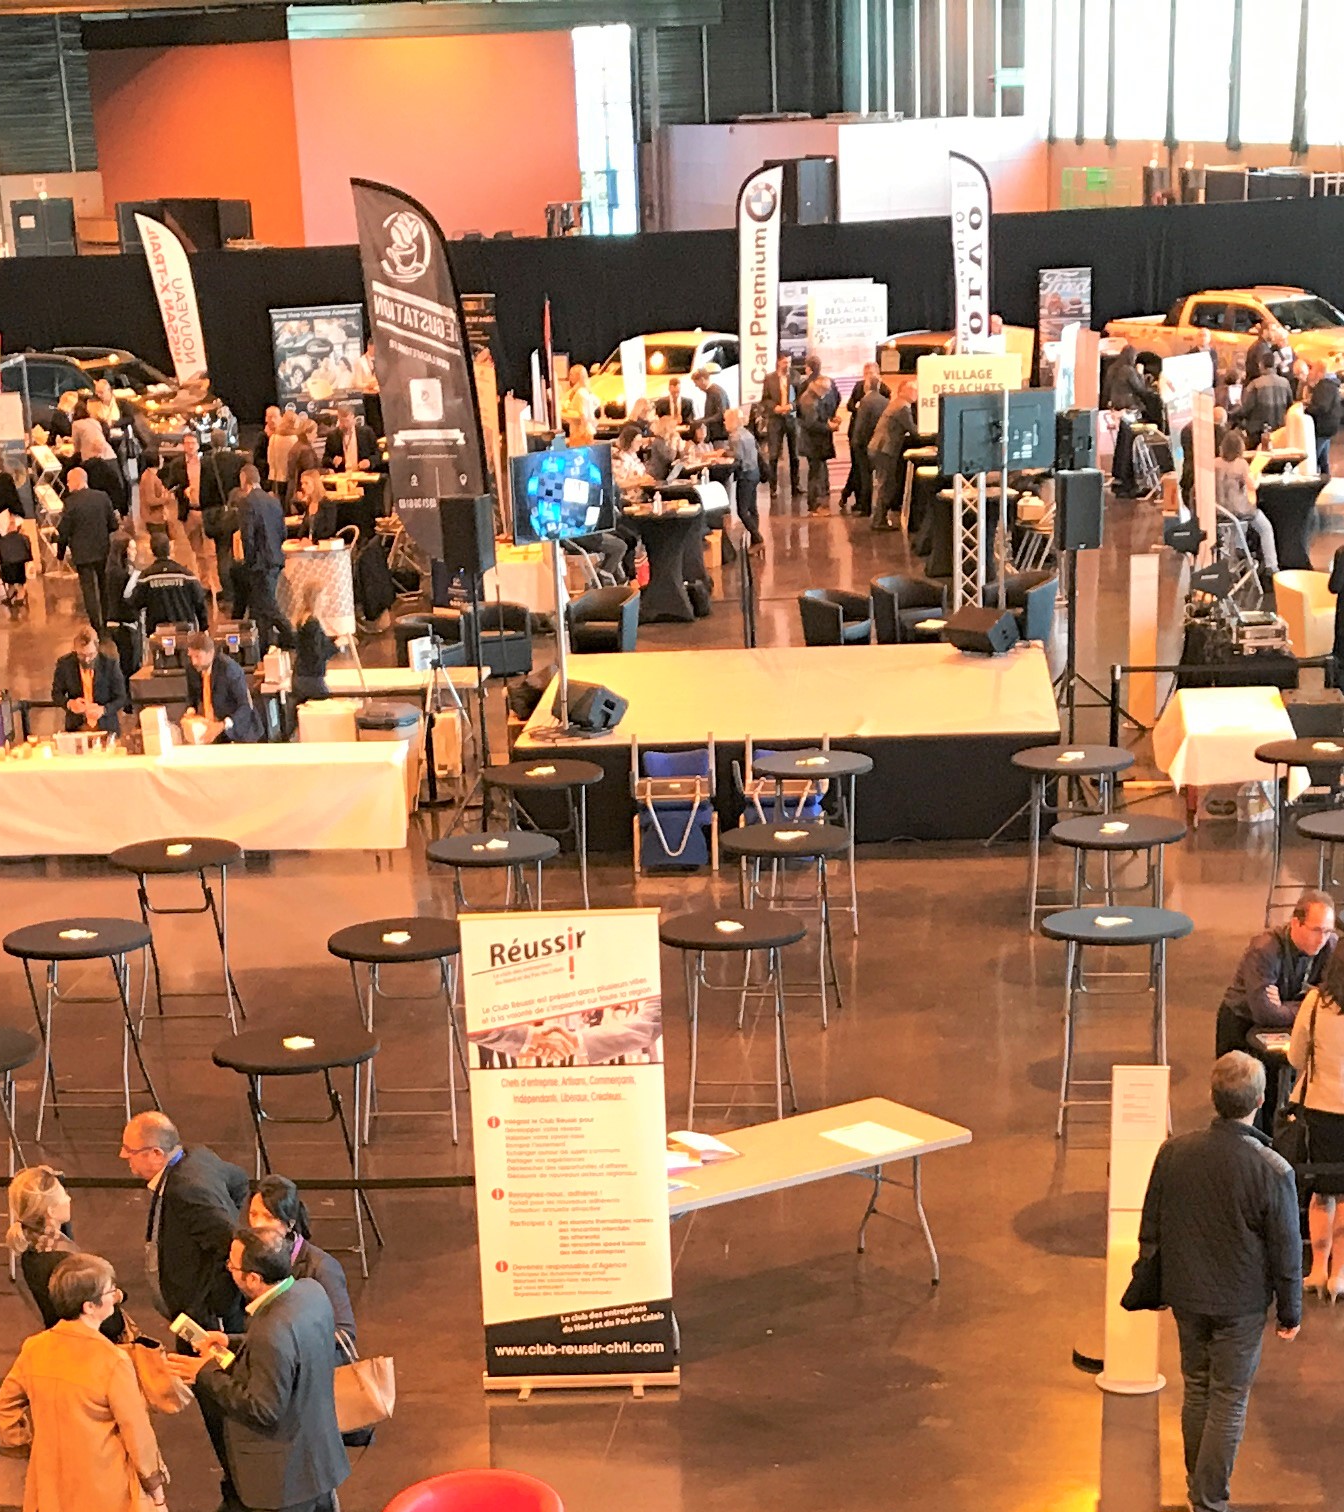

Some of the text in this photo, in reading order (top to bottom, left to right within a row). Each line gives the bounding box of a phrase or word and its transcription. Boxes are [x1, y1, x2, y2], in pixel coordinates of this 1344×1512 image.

[750, 227, 768, 386] Car Premium
[943, 369, 993, 381] VILLAGE
[933, 382, 1004, 394] DES ACHATS
[489, 926, 586, 967] Réussir
[492, 1004, 509, 1012] Club
[511, 998, 535, 1011] Réussir
[549, 991, 576, 1002] présent
[578, 987, 595, 996] dans
[597, 981, 628, 993] plusieurs
[629, 977, 648, 988] villes
[496, 1014, 505, 1022] la
[506, 1008, 533, 1020] volonté
[534, 1005, 544, 1014] de
[587, 996, 598, 1004] sur
[599, 992, 617, 1002] toute
[619, 990, 627, 999] la
[628, 986, 652, 998] région
[501, 1077, 519, 1088] Chefs
[561, 1305, 648, 1323] Le club des entreprises
[562, 1311, 665, 1334] du Nord et du Pas de Calais
[495, 1342, 665, 1357] www.club-reussir-chti.com
